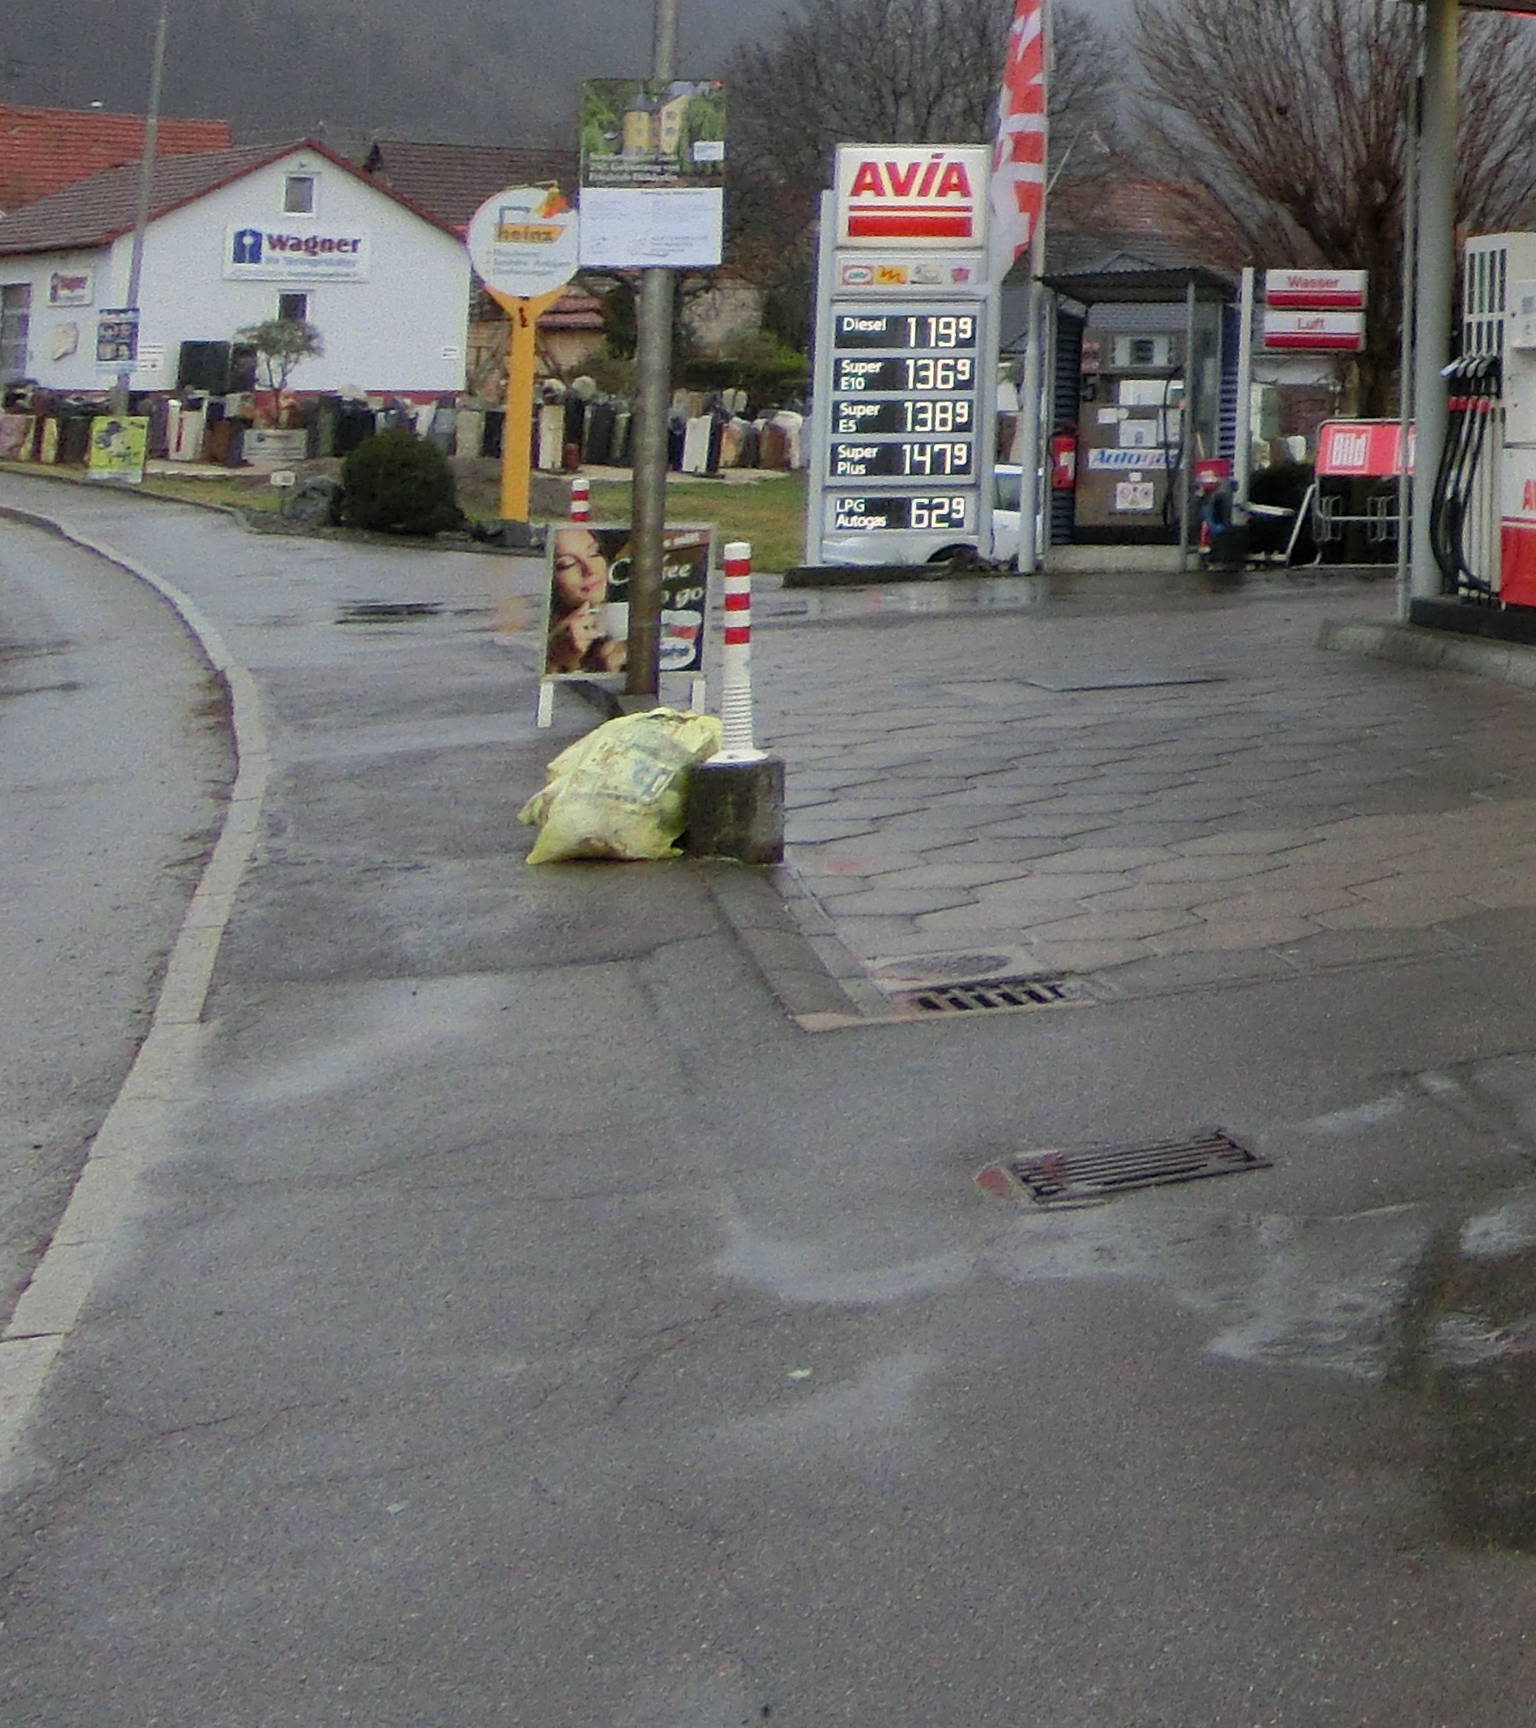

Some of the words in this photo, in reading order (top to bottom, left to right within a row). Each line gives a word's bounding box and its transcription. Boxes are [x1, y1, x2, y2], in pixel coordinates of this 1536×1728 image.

[266, 233, 362, 257] Wagner
[1287, 275, 1341, 289] Wasser
[842, 317, 887, 332] Diesel
[1297, 317, 1326, 330] Luft
[840, 359, 884, 376] Super
[840, 376, 866, 391] E10
[838, 402, 881, 419] Super
[838, 419, 857, 433] E5
[837, 444, 879, 462] Super
[836, 461, 867, 475] Plus
[835, 498, 866, 513] LPG
[835, 513, 887, 529] Autogas
